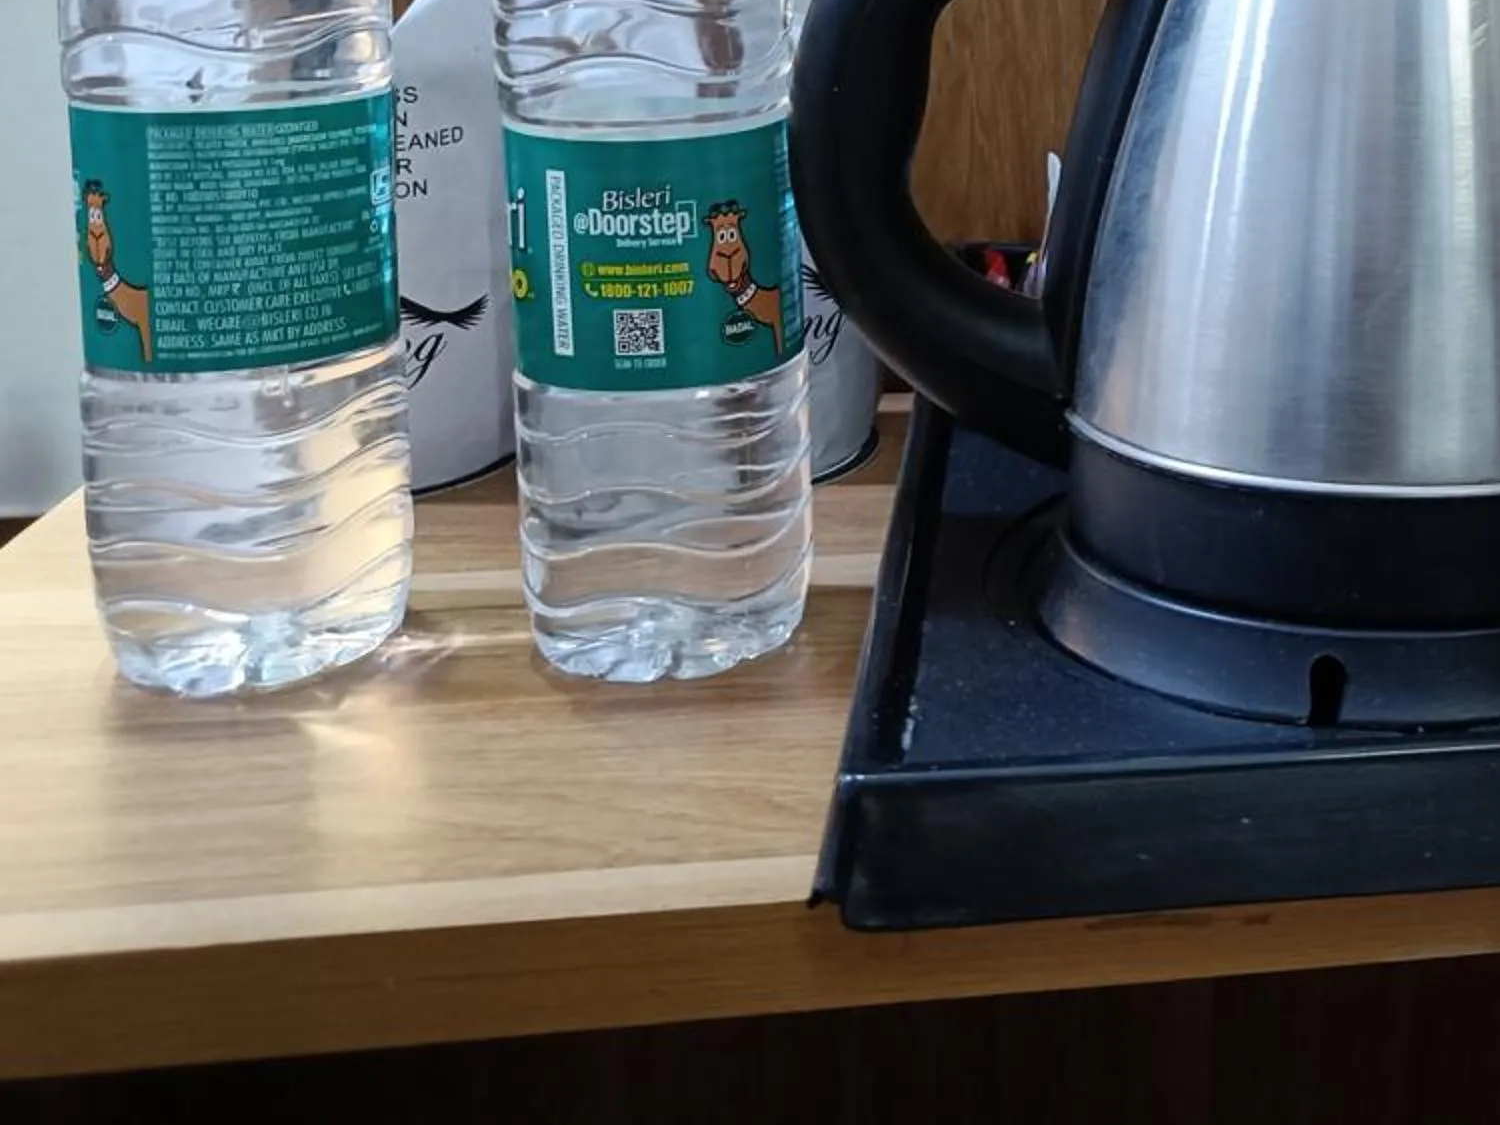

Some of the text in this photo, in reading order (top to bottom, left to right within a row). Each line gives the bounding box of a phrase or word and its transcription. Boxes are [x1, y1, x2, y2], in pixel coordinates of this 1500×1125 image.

[602, 184, 670, 212] Bisleri
[573, 208, 691, 246] @Doorstep
[155, 300, 199, 314] CONTACT
[203, 296, 263, 314] CUSTOMER
[265, 294, 292, 310] CARE
[210, 332, 242, 347] SAME
[245, 331, 260, 345] AS
[287, 325, 301, 340] BY
[303, 317, 348, 336] ADDRESS
[556, 307, 570, 350] WATER
